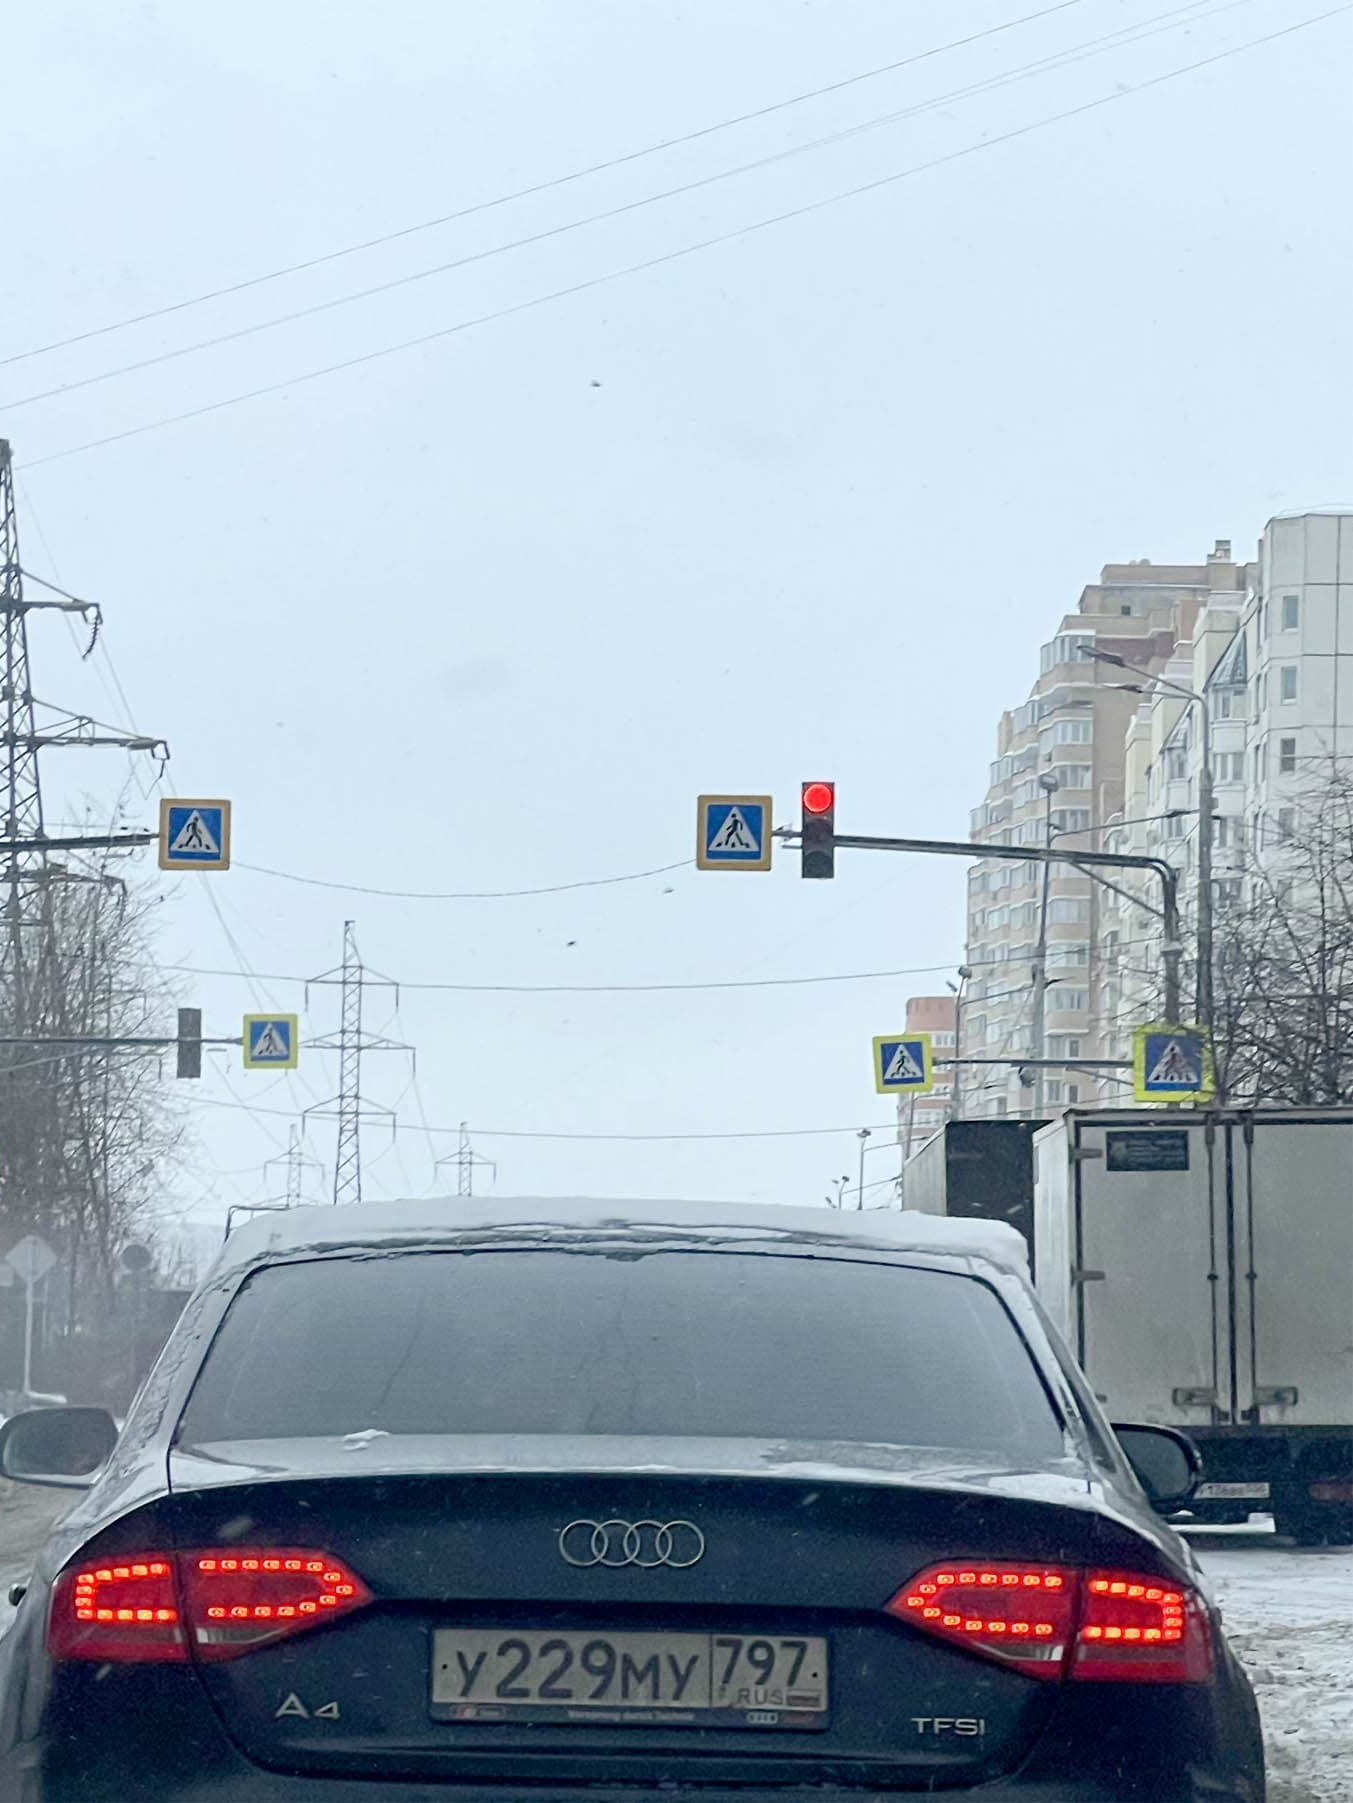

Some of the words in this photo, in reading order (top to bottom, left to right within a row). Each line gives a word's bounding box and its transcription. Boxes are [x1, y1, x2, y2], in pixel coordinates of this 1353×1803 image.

[456, 1638, 699, 1701] У229МУ
[716, 1638, 808, 1687] 797
[275, 1692, 340, 1719] A4
[738, 1688, 784, 1705] RUS
[910, 1718, 985, 1736] TFSI
